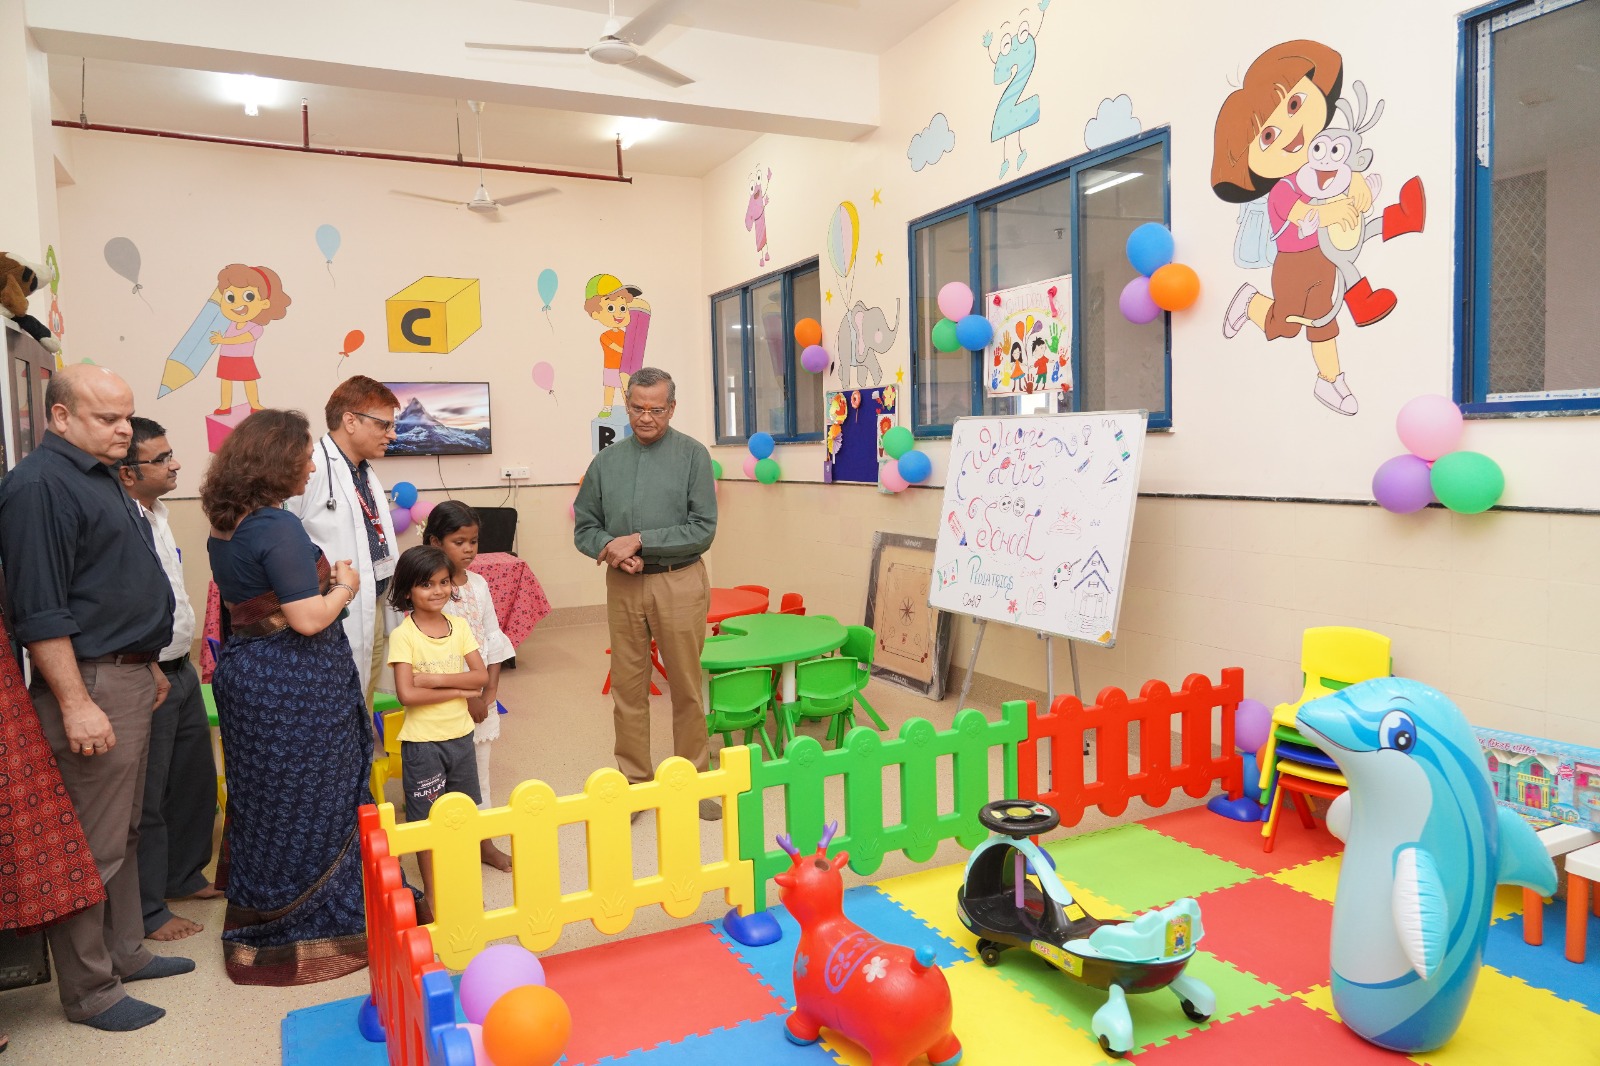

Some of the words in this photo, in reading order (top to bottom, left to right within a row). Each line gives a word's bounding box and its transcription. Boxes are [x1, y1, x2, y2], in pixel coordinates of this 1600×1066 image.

[400, 307, 431, 346] C
[598, 425, 616, 452] B
[413, 788, 432, 798] RUN
